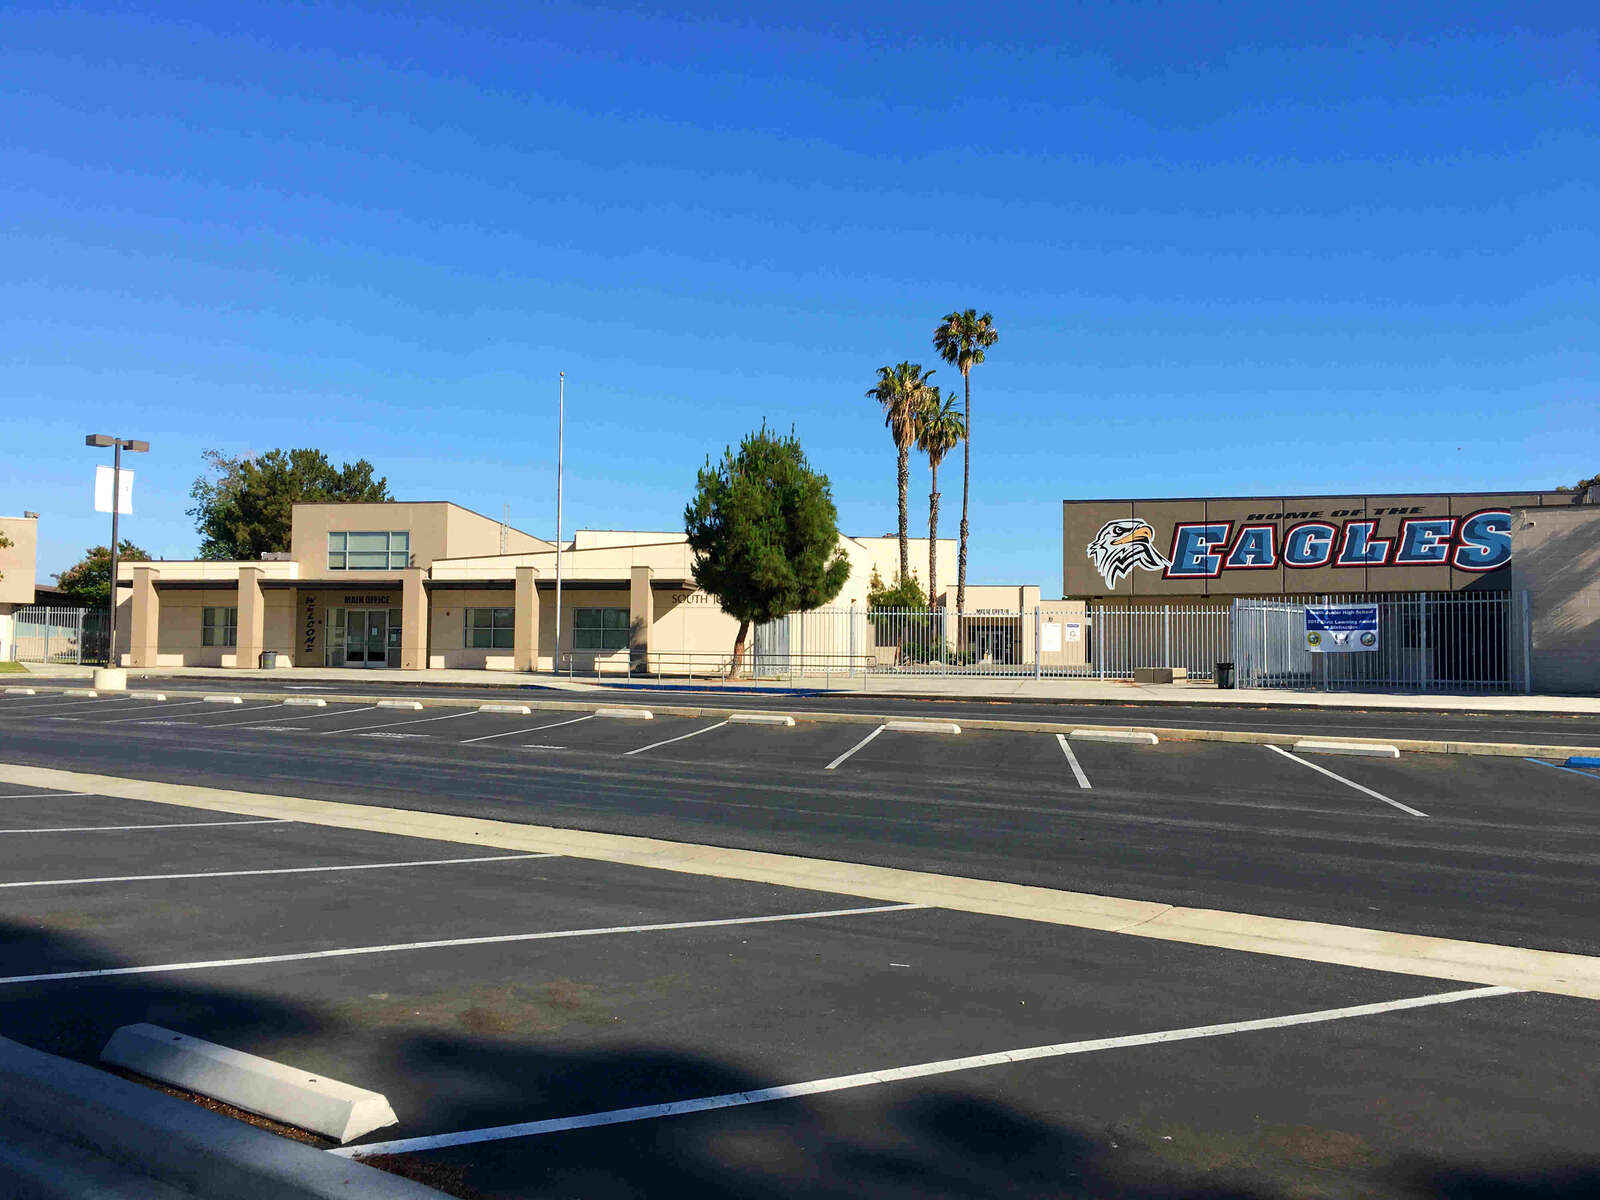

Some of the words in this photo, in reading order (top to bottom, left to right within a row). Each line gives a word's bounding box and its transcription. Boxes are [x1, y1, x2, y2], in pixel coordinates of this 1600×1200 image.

[1246, 510, 1325, 521] HOME
[1330, 508, 1364, 517] OF
[1373, 506, 1425, 516] THE
[1161, 507, 1512, 580] EAGLES
[344, 595, 363, 604] MAIN
[365, 595, 390, 604] OFFICE
[672, 594, 708, 604] SOUTH
[304, 596, 315, 653] WELCOME
